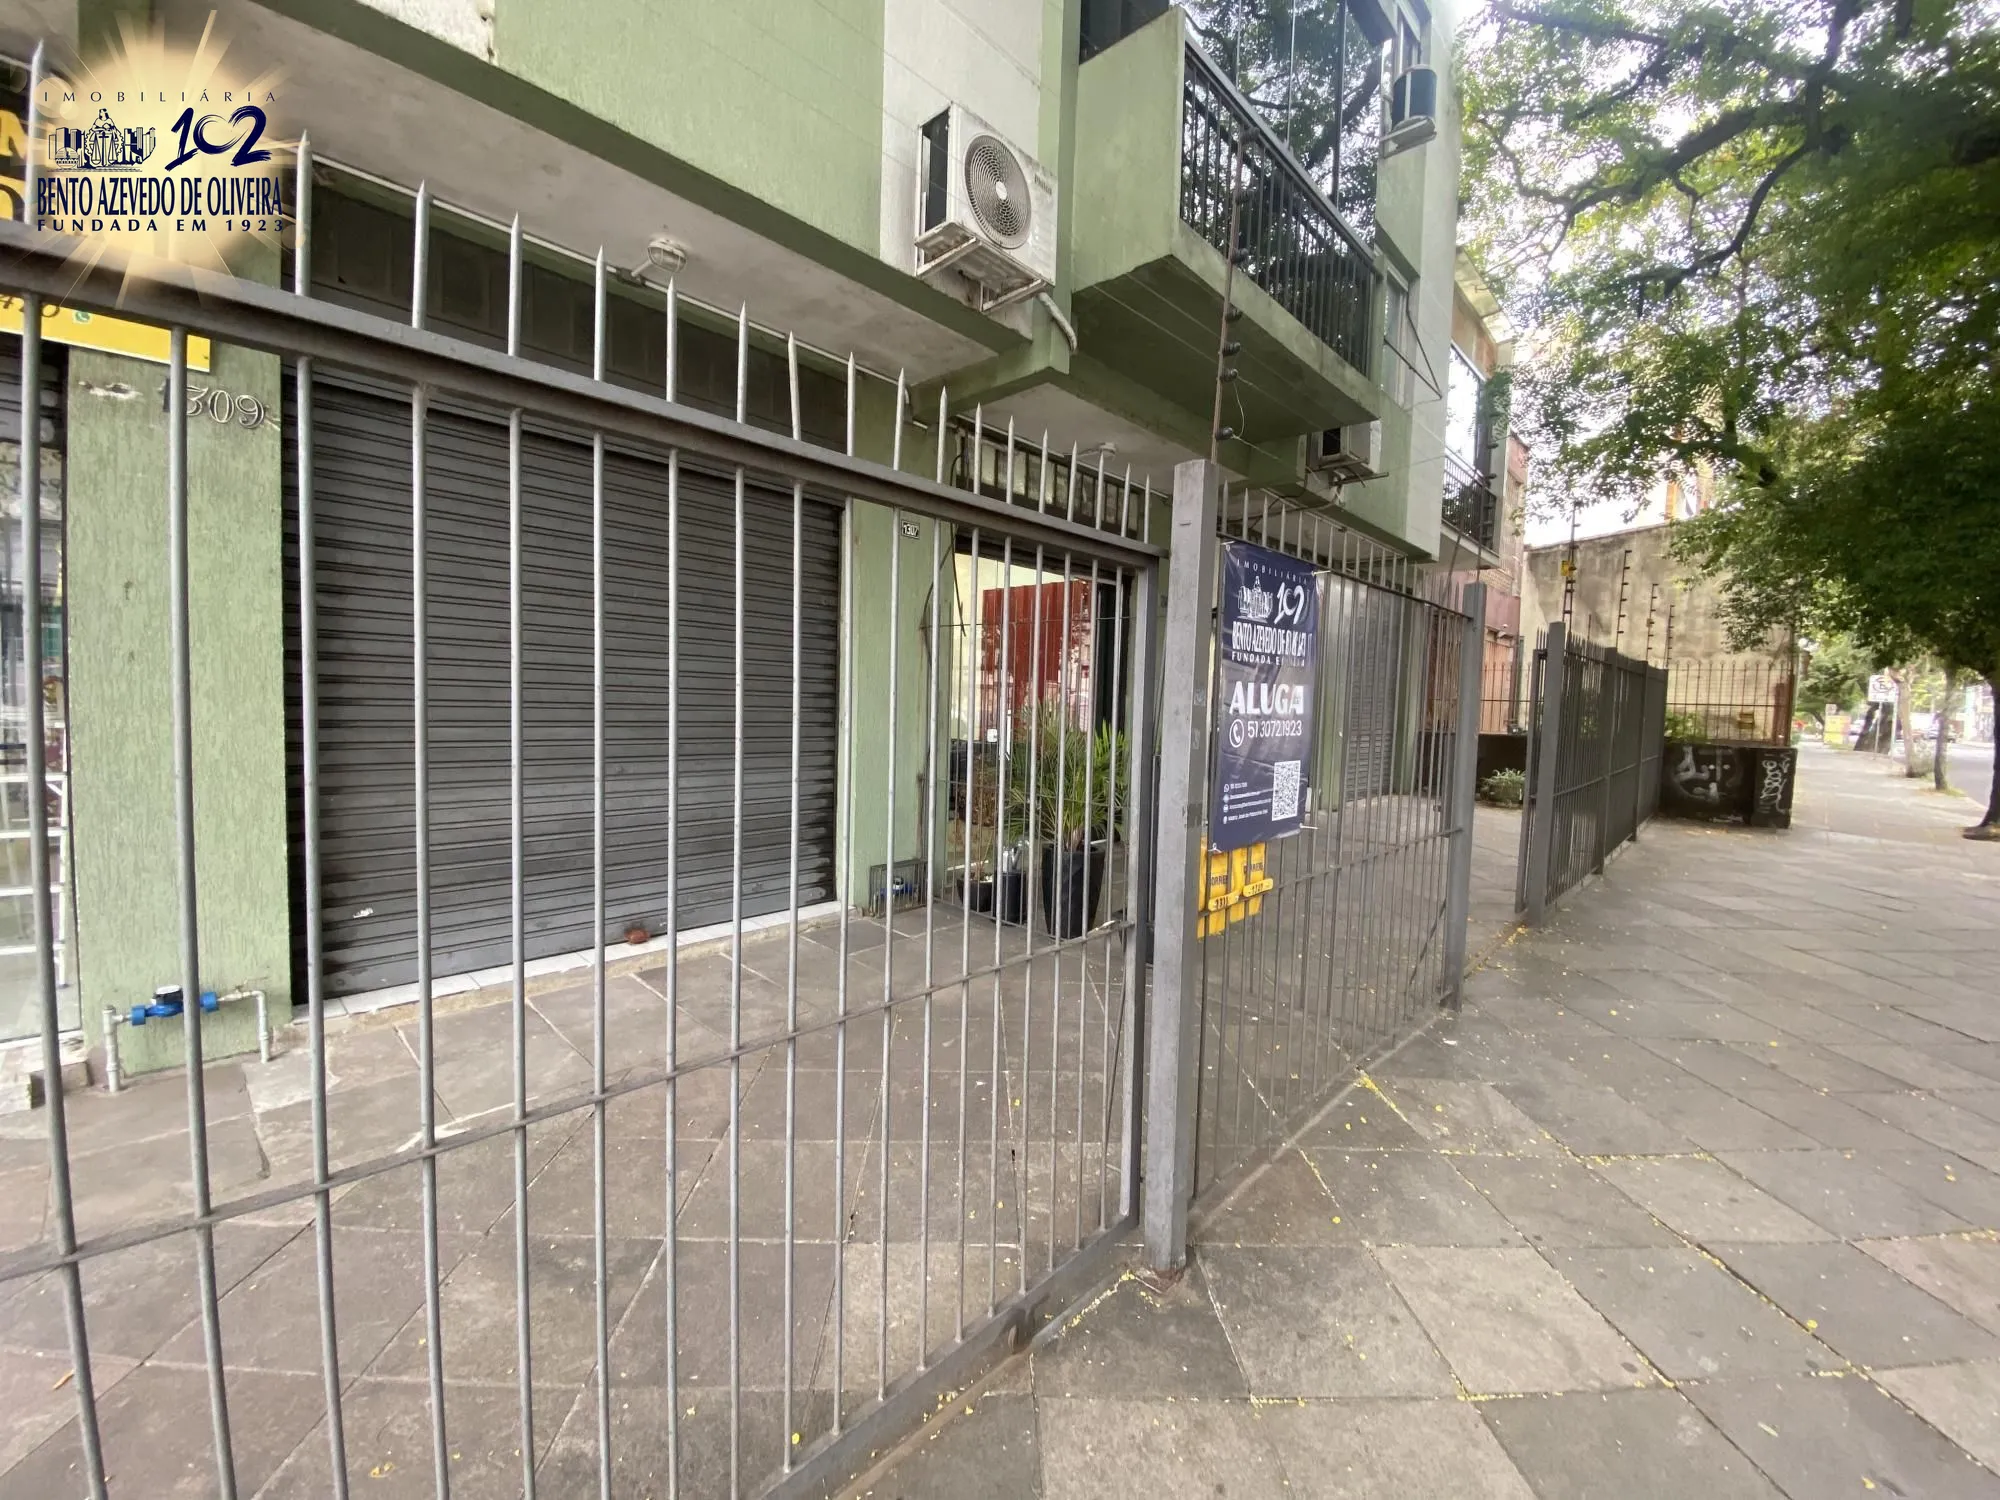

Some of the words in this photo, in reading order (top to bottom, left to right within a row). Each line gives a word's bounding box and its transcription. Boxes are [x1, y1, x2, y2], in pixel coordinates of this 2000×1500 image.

[1232, 620, 1252, 652] BENTO
[1251, 623, 1277, 655] AZEVEDO
[1231, 650, 1271, 665] FUNDADA
[1228, 680, 1305, 716] ALUGA
[1247, 720, 1259, 739] 51
